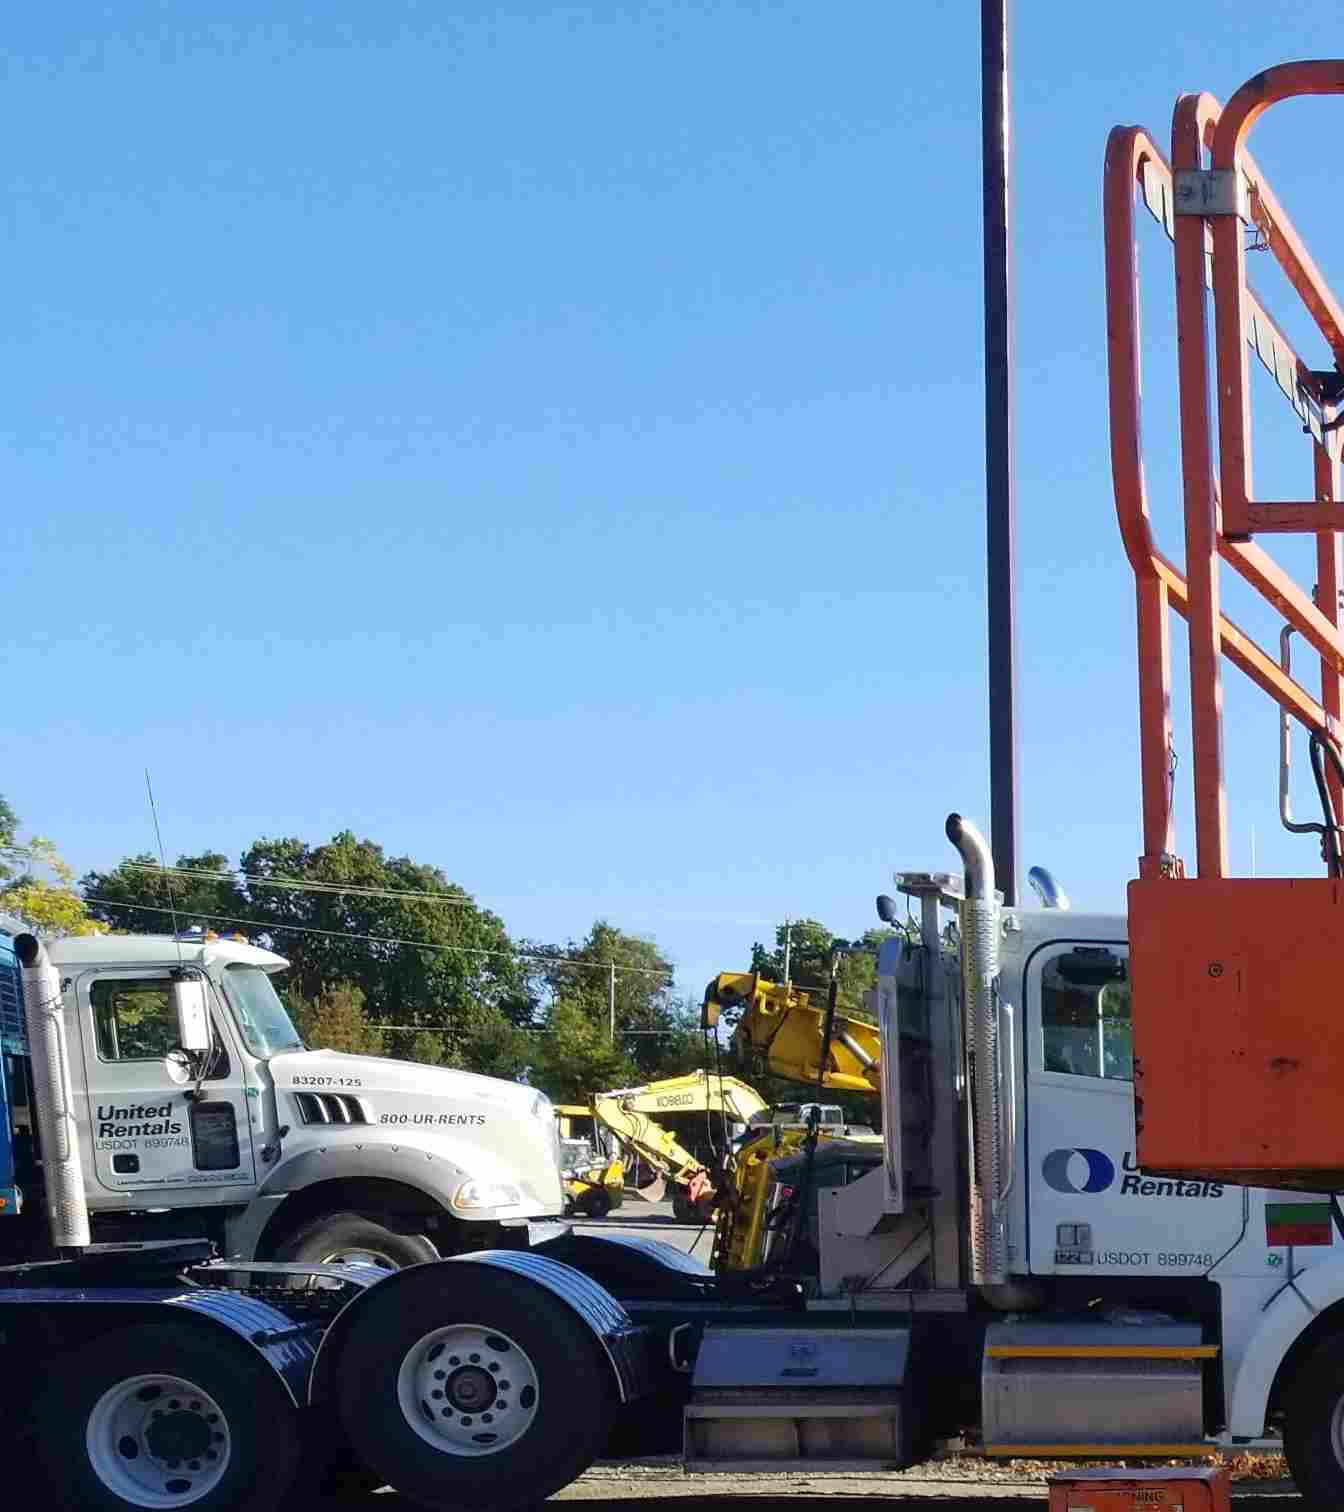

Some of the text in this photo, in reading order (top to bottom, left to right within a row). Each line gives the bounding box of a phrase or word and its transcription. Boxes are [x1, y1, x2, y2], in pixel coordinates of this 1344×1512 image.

[97, 1102, 172, 1121] United
[98, 1119, 182, 1138] Rentals
[1120, 1175, 1224, 1199] Rentals
[1097, 1253, 1150, 1265] USDOT
